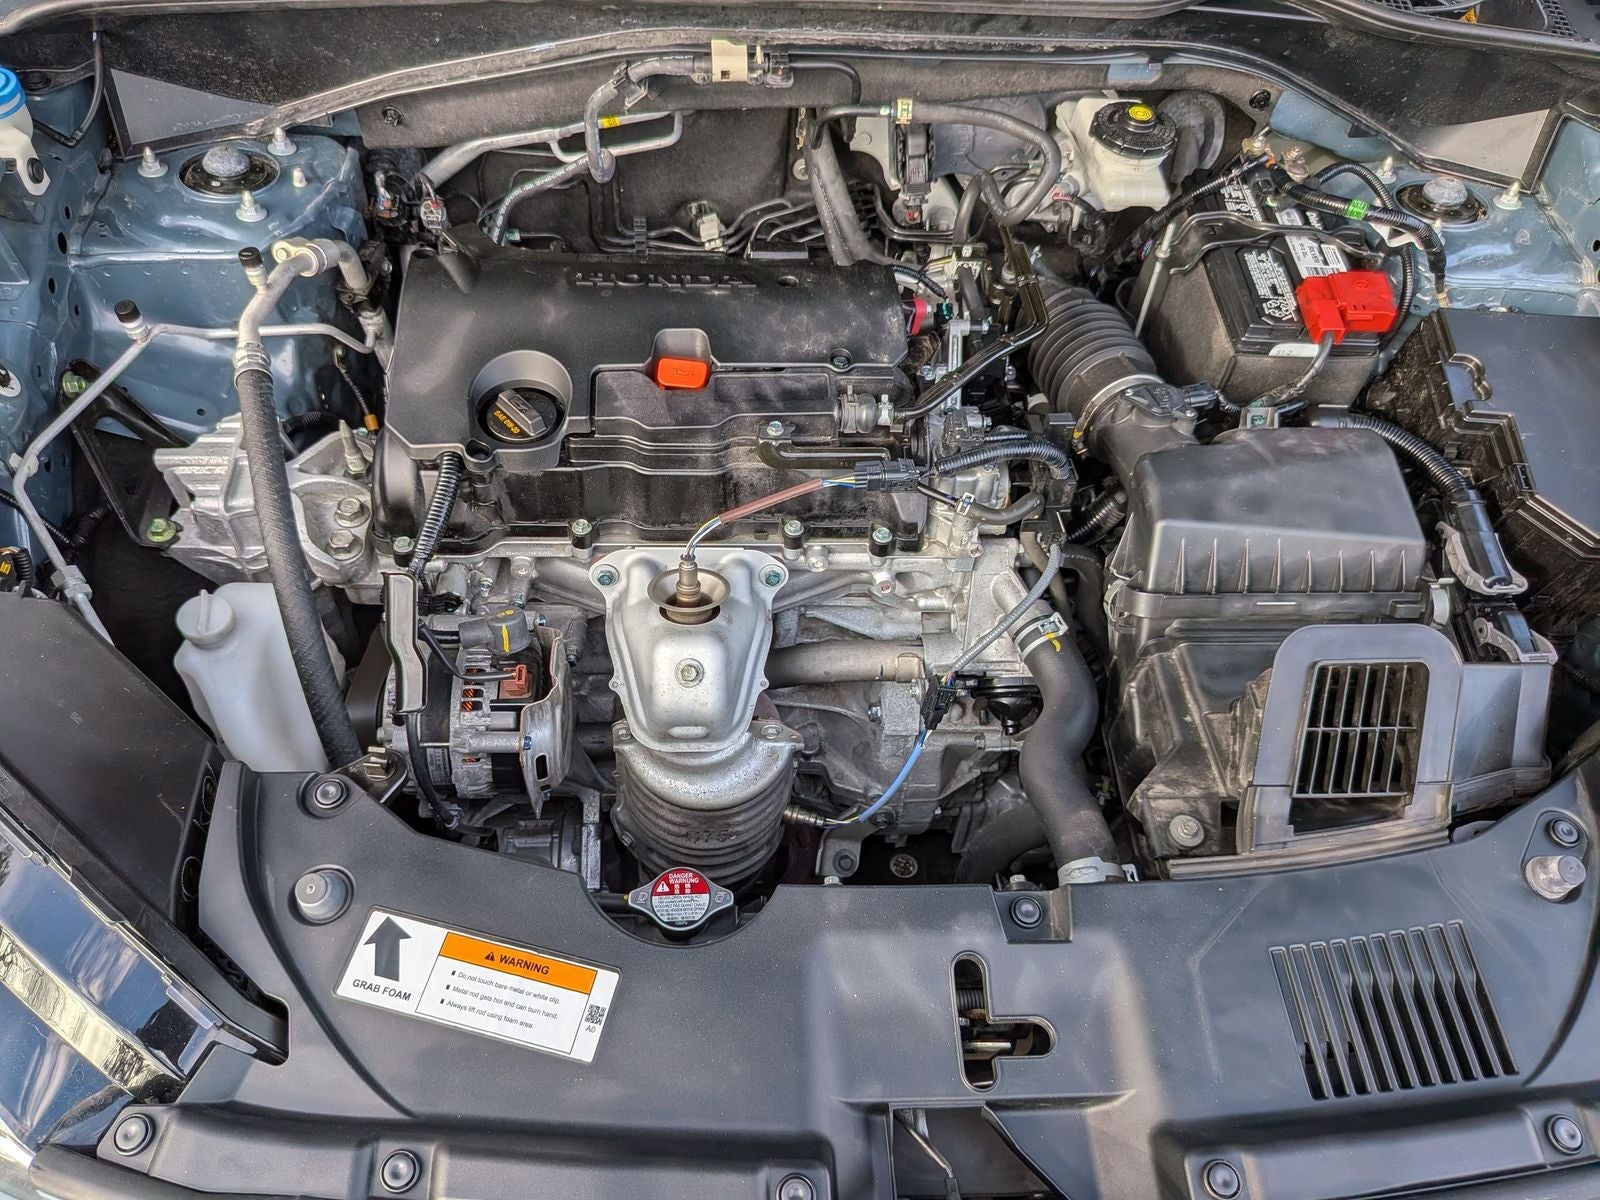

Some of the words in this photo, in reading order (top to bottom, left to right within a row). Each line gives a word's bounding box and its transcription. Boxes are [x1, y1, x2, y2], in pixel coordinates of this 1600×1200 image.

[575, 272, 757, 288] HONDA
[493, 410, 506, 422] SAE
[504, 420, 520, 434] 0W-20
[499, 954, 550, 976] WARNING
[352, 978, 381, 993] GRAB
[382, 986, 412, 1001] FOAM
[458, 971, 466, 980] Do
[467, 974, 477, 982] not
[478, 976, 494, 986] touch
[494, 981, 508, 990] bare
[509, 985, 525, 995] metal
[532, 990, 548, 1001] white
[549, 994, 560, 1005] clip.
[446, 1000, 467, 1011] Always
[476, 1007, 486, 1016] rod
[487, 1011, 502, 1021] using
[503, 1015, 519, 1025] foam
[519, 1020, 534, 1029] area.
[452, 986, 468, 995] Metal
[469, 990, 479, 998] rod
[480, 993, 493, 1002] gets
[493, 996, 503, 1004] hot
[504, 999, 515, 1008] and
[516, 1002, 526, 1011] can
[527, 1005, 541, 1015] burn
[542, 1009, 558, 1020] hand.
[585, 1024, 596, 1033] A0
